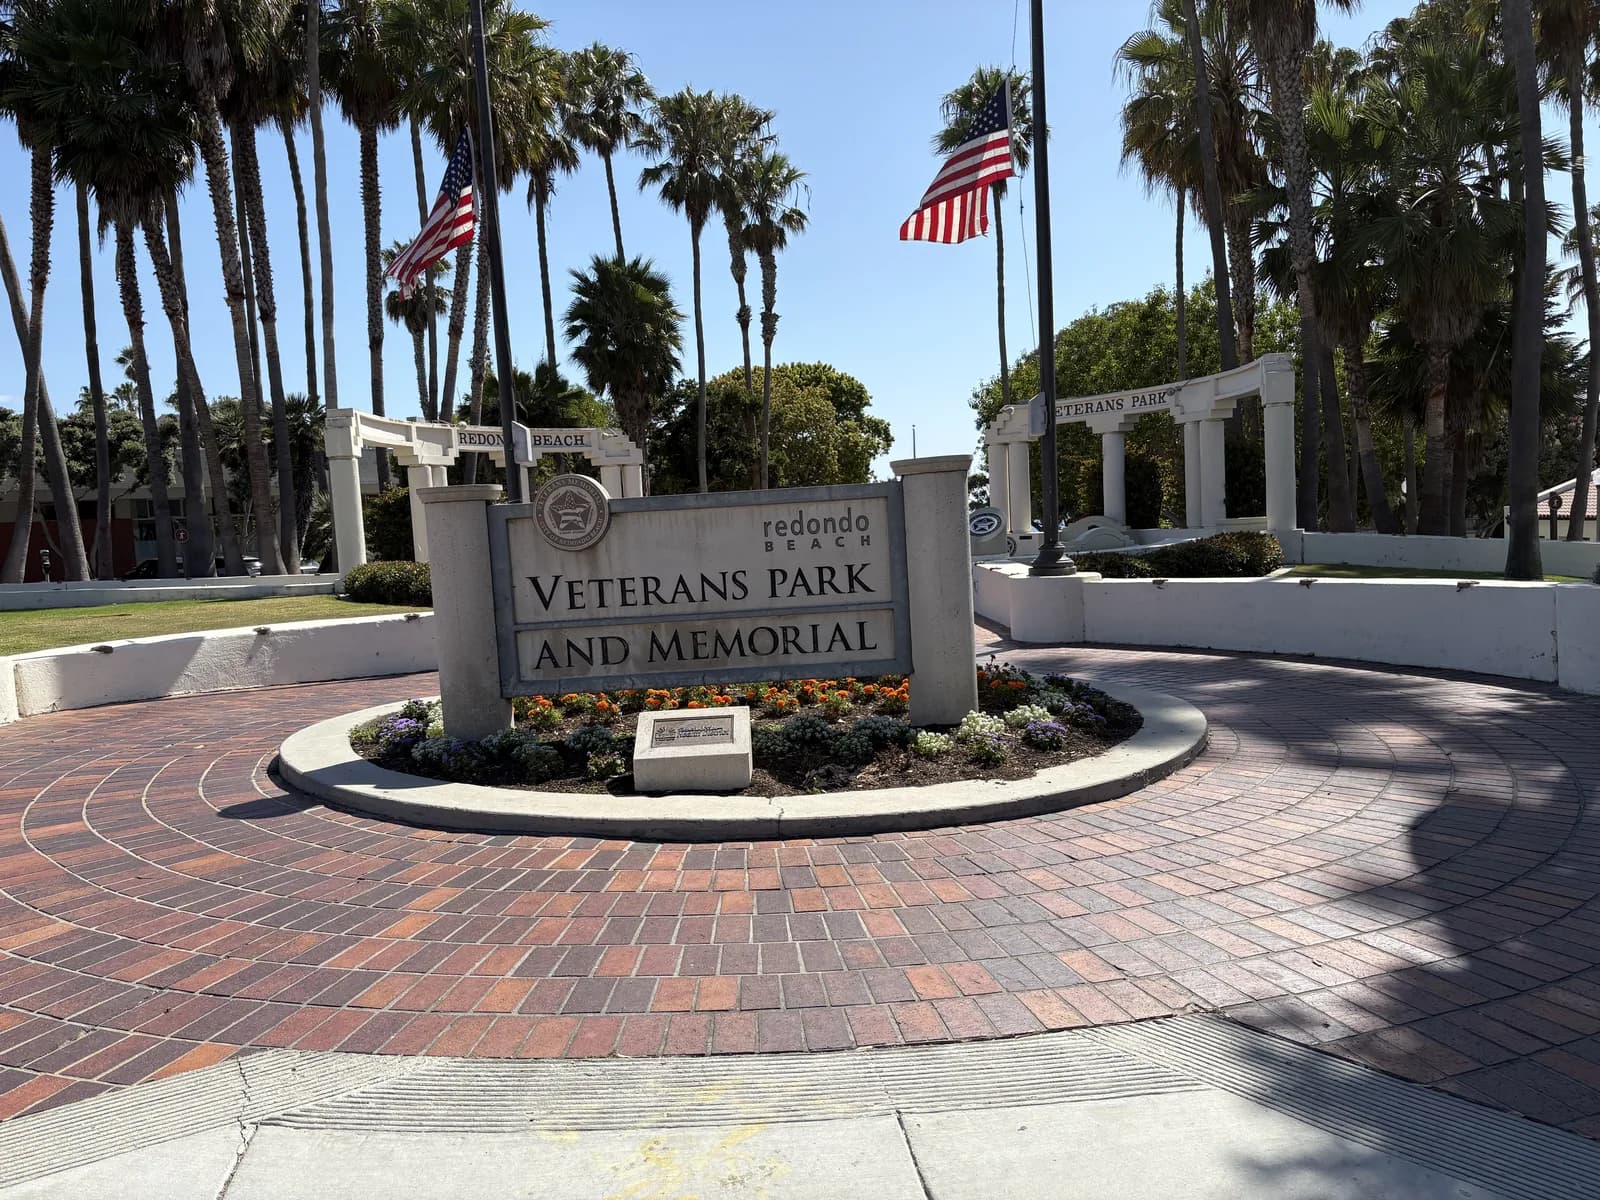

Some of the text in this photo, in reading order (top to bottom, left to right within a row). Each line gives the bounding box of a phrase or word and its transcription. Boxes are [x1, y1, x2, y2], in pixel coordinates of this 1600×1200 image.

[1055, 392, 1168, 416] ETERANS PARK
[458, 432, 585, 446] REDON BEACH
[763, 507, 870, 537] redondo
[764, 535, 871, 552] BEACH
[527, 563, 875, 611] VETERANS PARK
[534, 621, 878, 670] AND MEMORIAL
